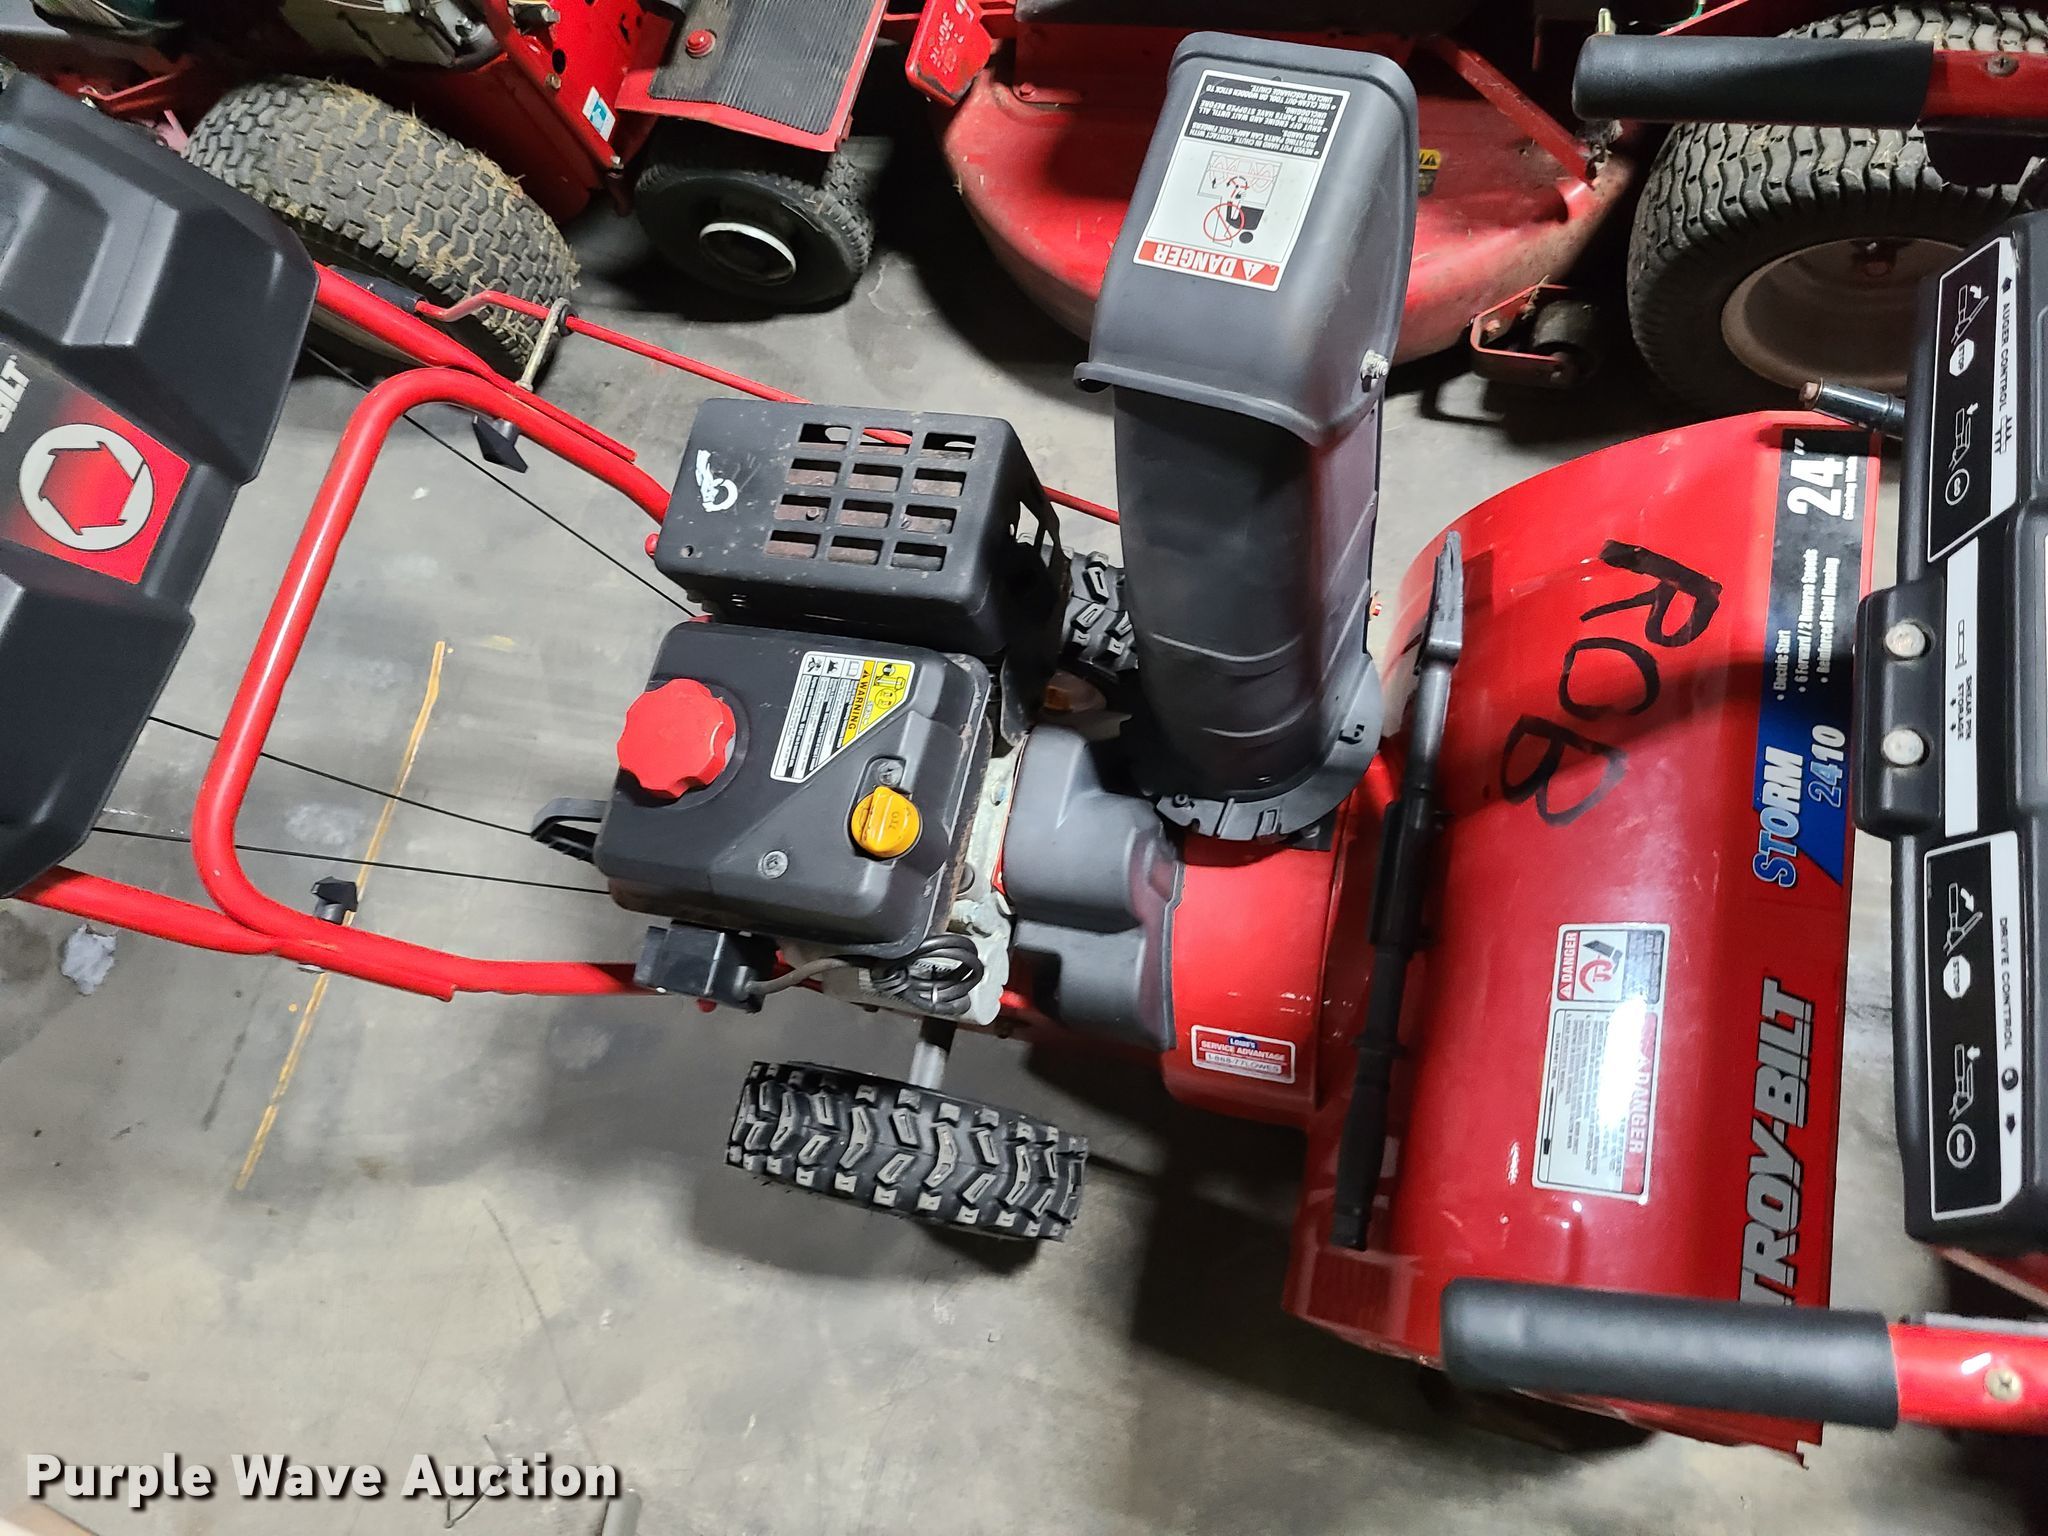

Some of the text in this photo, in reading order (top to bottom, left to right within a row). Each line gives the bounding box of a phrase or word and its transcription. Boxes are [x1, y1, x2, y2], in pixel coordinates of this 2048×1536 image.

[1154, 243, 1239, 278] DANGER
[2000, 302, 2011, 412] AUGER CONTROL
[1773, 629, 1791, 690] Electric Start
[1816, 621, 1834, 673] Reinforced
[849, 681, 868, 731] WARNING
[1500, 539, 1723, 827] ROB
[1794, 675, 1808, 683] 6
[1808, 724, 1846, 808] 2410
[1752, 746, 1803, 887] STORM
[1561, 931, 1577, 983] DANGER
[2000, 917, 2012, 1051] DRIVE CONTROL
[1201, 1040, 1285, 1061] SERVICE ADVANTAGE
[1628, 1070, 1650, 1153] DANGER
